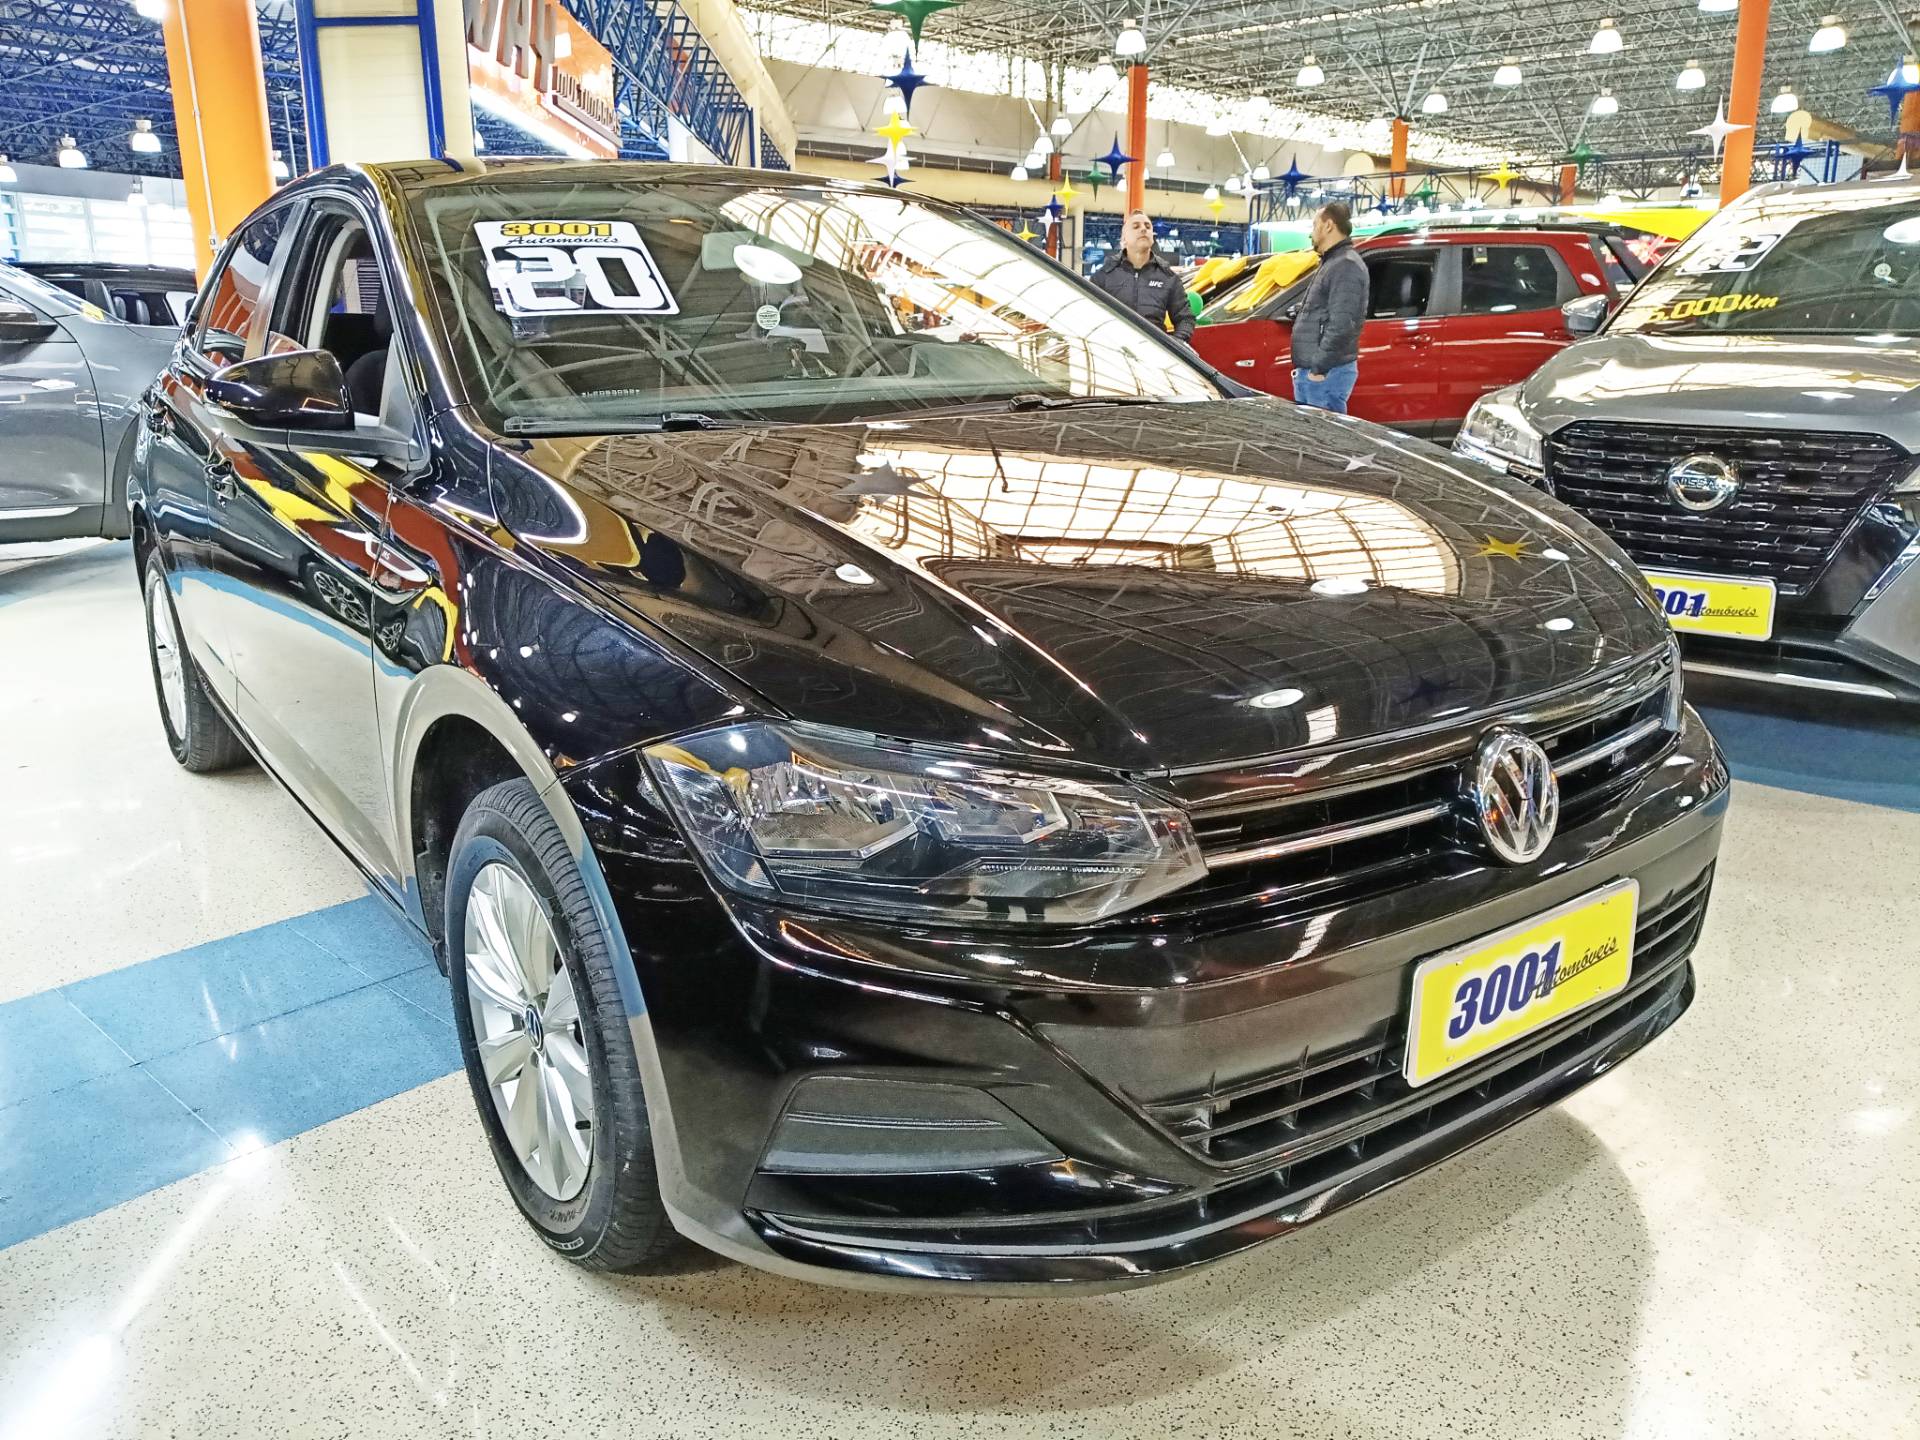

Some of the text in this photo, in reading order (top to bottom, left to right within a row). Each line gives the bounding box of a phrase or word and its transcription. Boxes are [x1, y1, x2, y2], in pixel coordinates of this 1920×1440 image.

[500, 221, 613, 237] 3001
[504, 246, 666, 311] 20
[1148, 280, 1164, 288] UFC
[1448, 936, 1619, 1041] 3001 Automóveis
